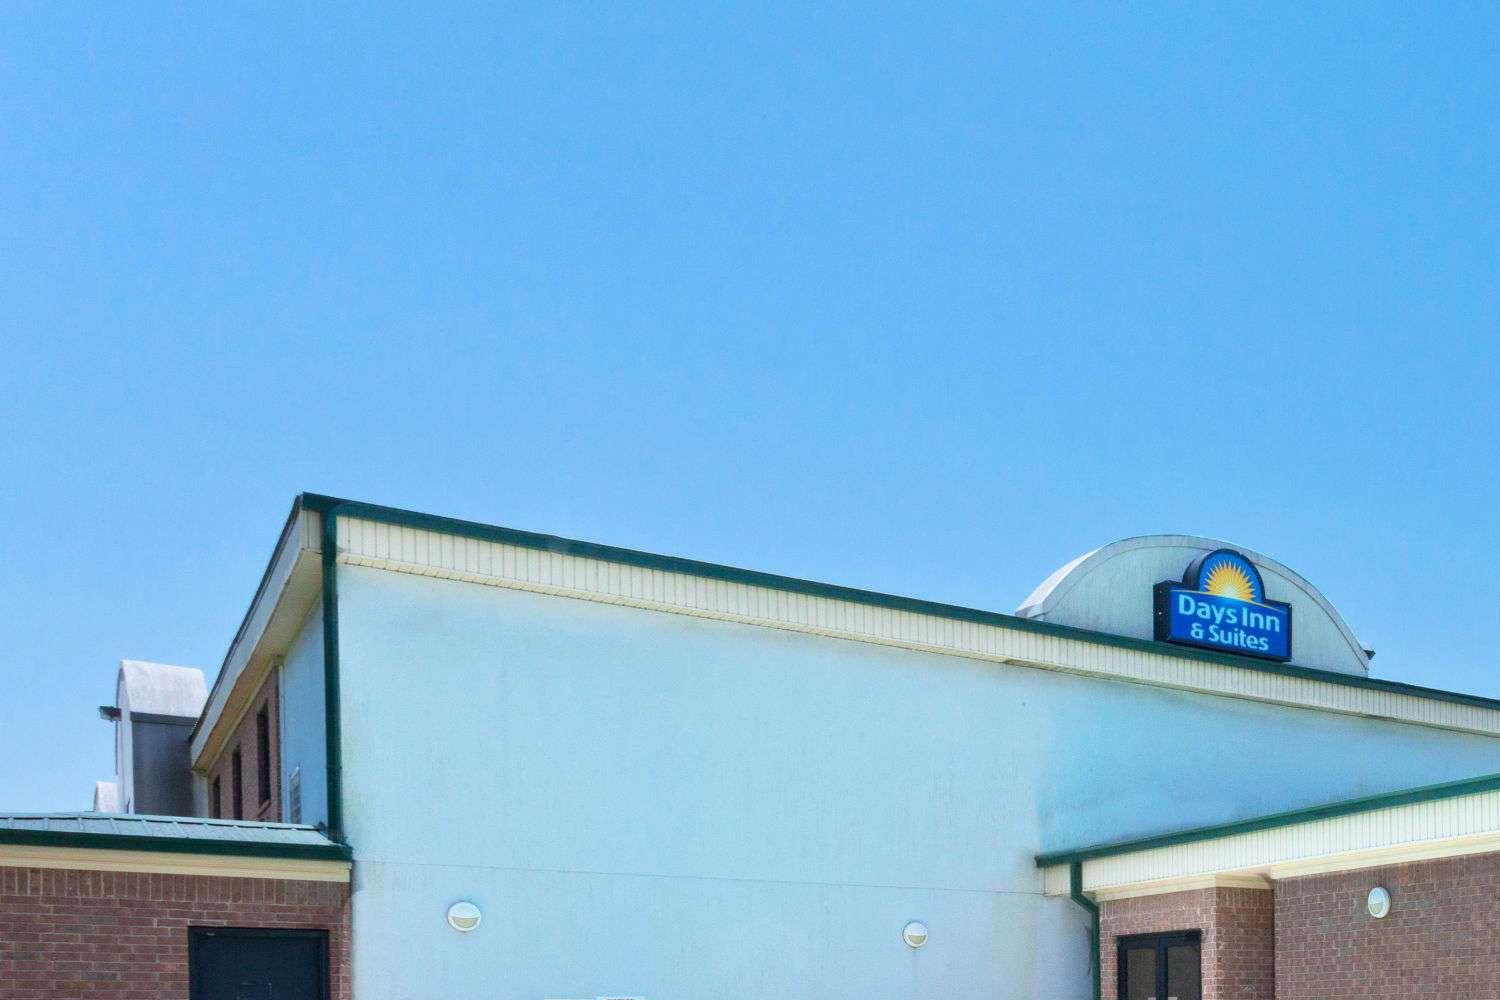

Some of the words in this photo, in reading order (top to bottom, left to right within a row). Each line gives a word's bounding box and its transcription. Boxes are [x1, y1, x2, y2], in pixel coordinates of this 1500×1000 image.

[1178, 594, 1238, 624] Days
[1242, 607, 1280, 633] Inn
[1190, 622, 1205, 640] &
[1208, 624, 1269, 652] Suites
